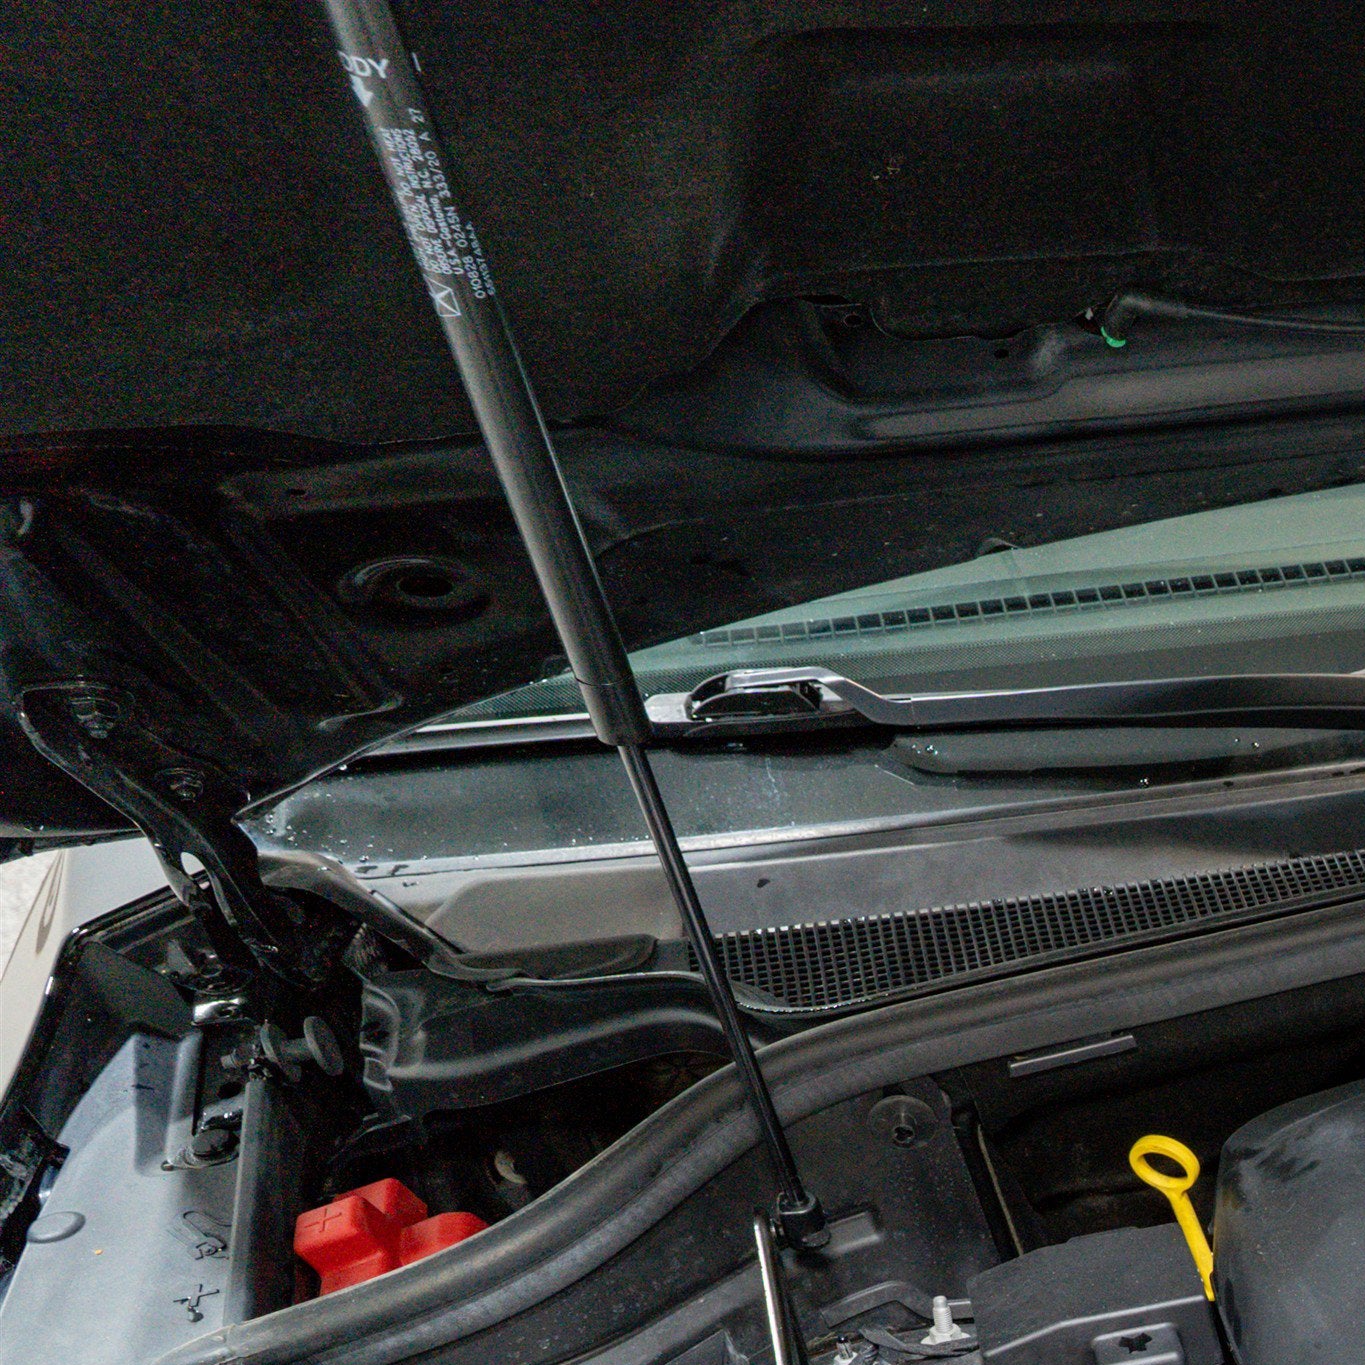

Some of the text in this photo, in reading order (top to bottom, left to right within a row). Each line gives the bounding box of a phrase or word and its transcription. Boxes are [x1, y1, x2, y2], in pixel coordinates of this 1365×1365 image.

[389, 128, 422, 186] INSTRUCTIONS
[391, 159, 406, 175] NOT
[400, 183, 413, 195] DO
[407, 106, 487, 298] 010828 0245N 333/20 A 27
[414, 195, 438, 232] DISPOSAL
[430, 238, 453, 273] OBSERVE
